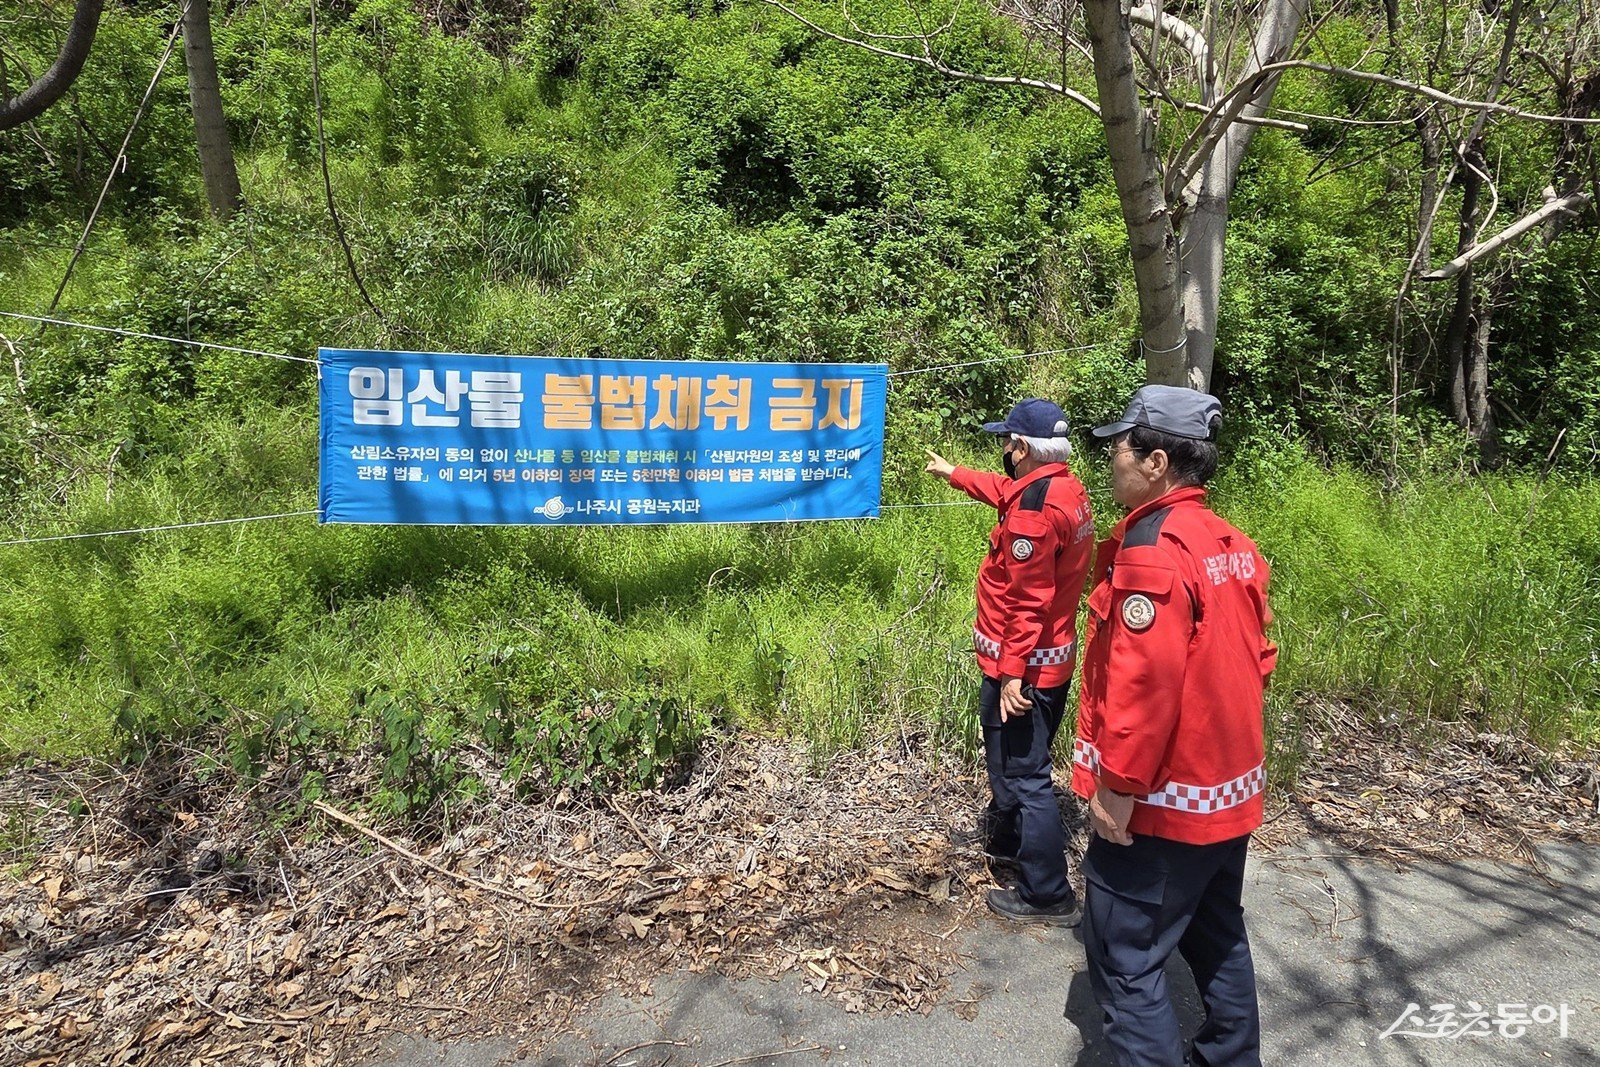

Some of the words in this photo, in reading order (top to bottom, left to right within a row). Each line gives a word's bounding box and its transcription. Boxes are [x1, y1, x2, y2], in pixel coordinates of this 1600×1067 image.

[348, 366, 524, 428] 임산물
[541, 373, 752, 431] 불법채취
[768, 377, 864, 431] 금지
[350, 445, 440, 462] 산림소유자의
[444, 447, 474, 463] 동의
[480, 448, 508, 463] 없이
[514, 448, 555, 464] 산나물
[561, 449, 575, 464] 등
[580, 449, 621, 464] 임산물
[626, 449, 678, 464] 불법채취
[683, 450, 697, 464] 시
[777, 449, 803, 463] 조성
[807, 449, 820, 463] 및
[824, 448, 861, 462] 관리에
[356, 465, 388, 480] 관한
[438, 467, 453, 482] 에
[458, 467, 487, 482] 의거
[492, 468, 516, 483] 5년
[521, 468, 563, 483] 이하의
[568, 468, 596, 483] 징역
[600, 469, 628, 483] 또는
[632, 468, 680, 483] 5천만원
[685, 468, 724, 482] 이하의
[728, 468, 754, 483] 벌금
[758, 468, 797, 482] 처벌을
[801, 467, 853, 482] 받습니다.
[577, 499, 621, 514] 나주시
[626, 498, 701, 514] 공원녹지과
